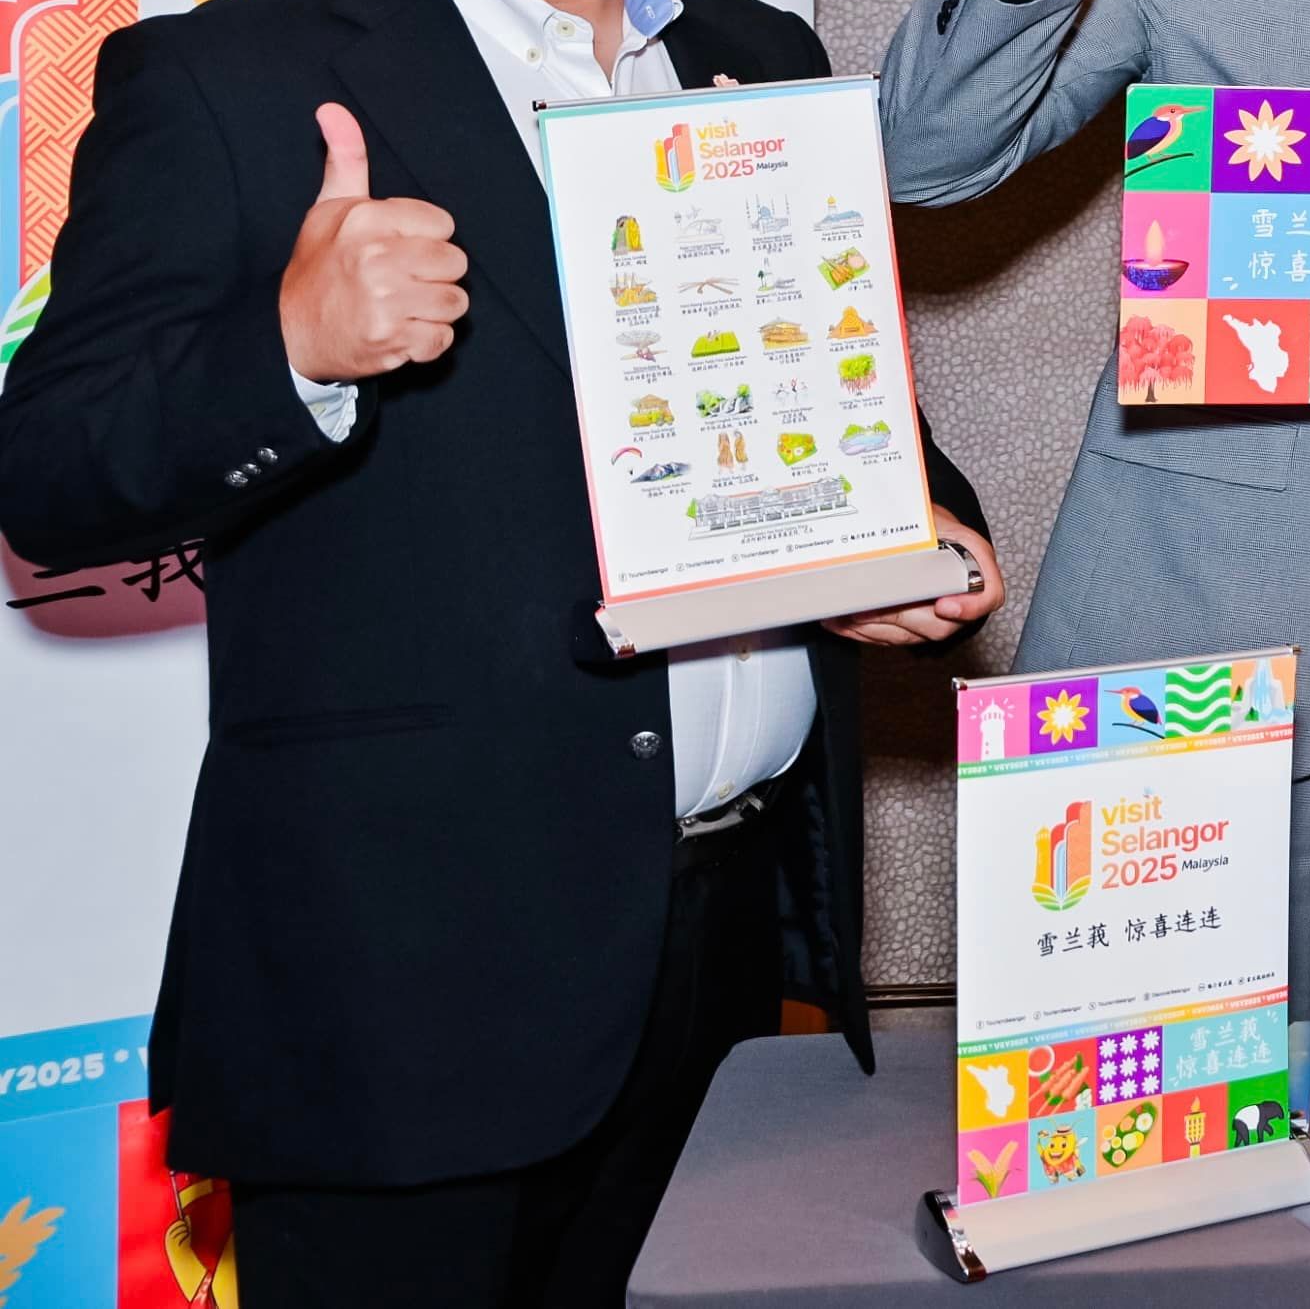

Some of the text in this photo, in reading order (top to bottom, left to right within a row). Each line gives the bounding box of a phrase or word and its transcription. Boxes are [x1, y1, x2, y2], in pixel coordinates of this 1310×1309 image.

[696, 121, 738, 140] visit
[699, 138, 785, 159] Selangor
[702, 159, 754, 180] 2025
[1101, 795, 1163, 826] visit
[1101, 820, 1230, 857] Selangor
[1101, 853, 1229, 889] 2025 Malaysia
[1037, 906, 1222, 957] 雪兰莪 惊喜连连
[0, 1052, 104, 1095] Y2025
